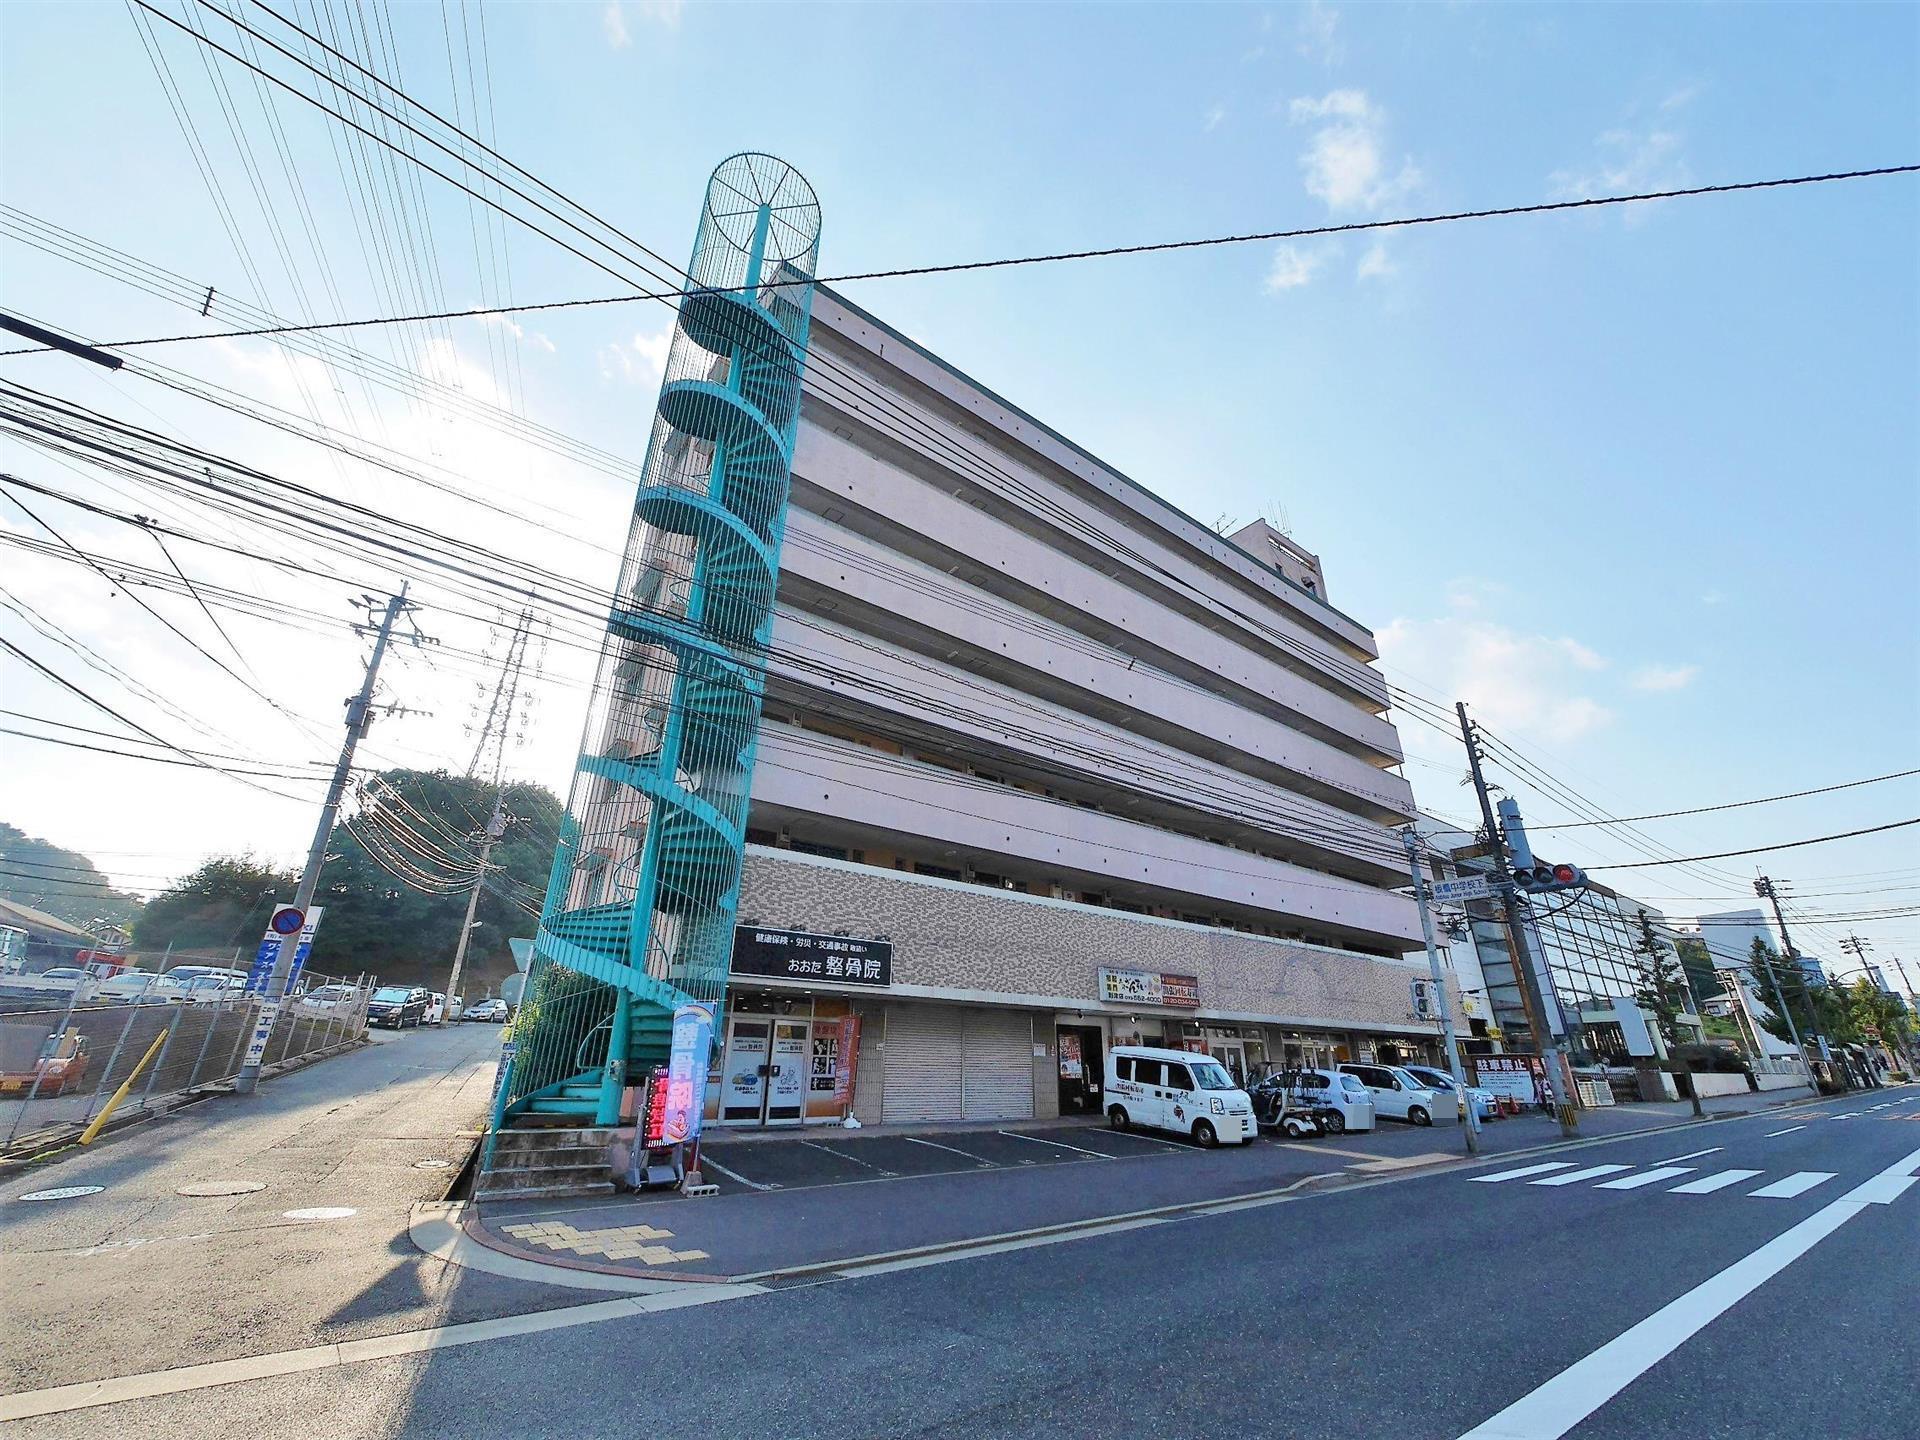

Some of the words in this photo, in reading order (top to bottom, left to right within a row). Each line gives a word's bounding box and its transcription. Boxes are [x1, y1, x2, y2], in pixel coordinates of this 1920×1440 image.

[788, 959, 822, 974] おおた
[825, 955, 882, 979] 整骨院
[251, 1016, 272, 1054] 工事中
[1476, 1058, 1527, 1071] 駐車禁止
